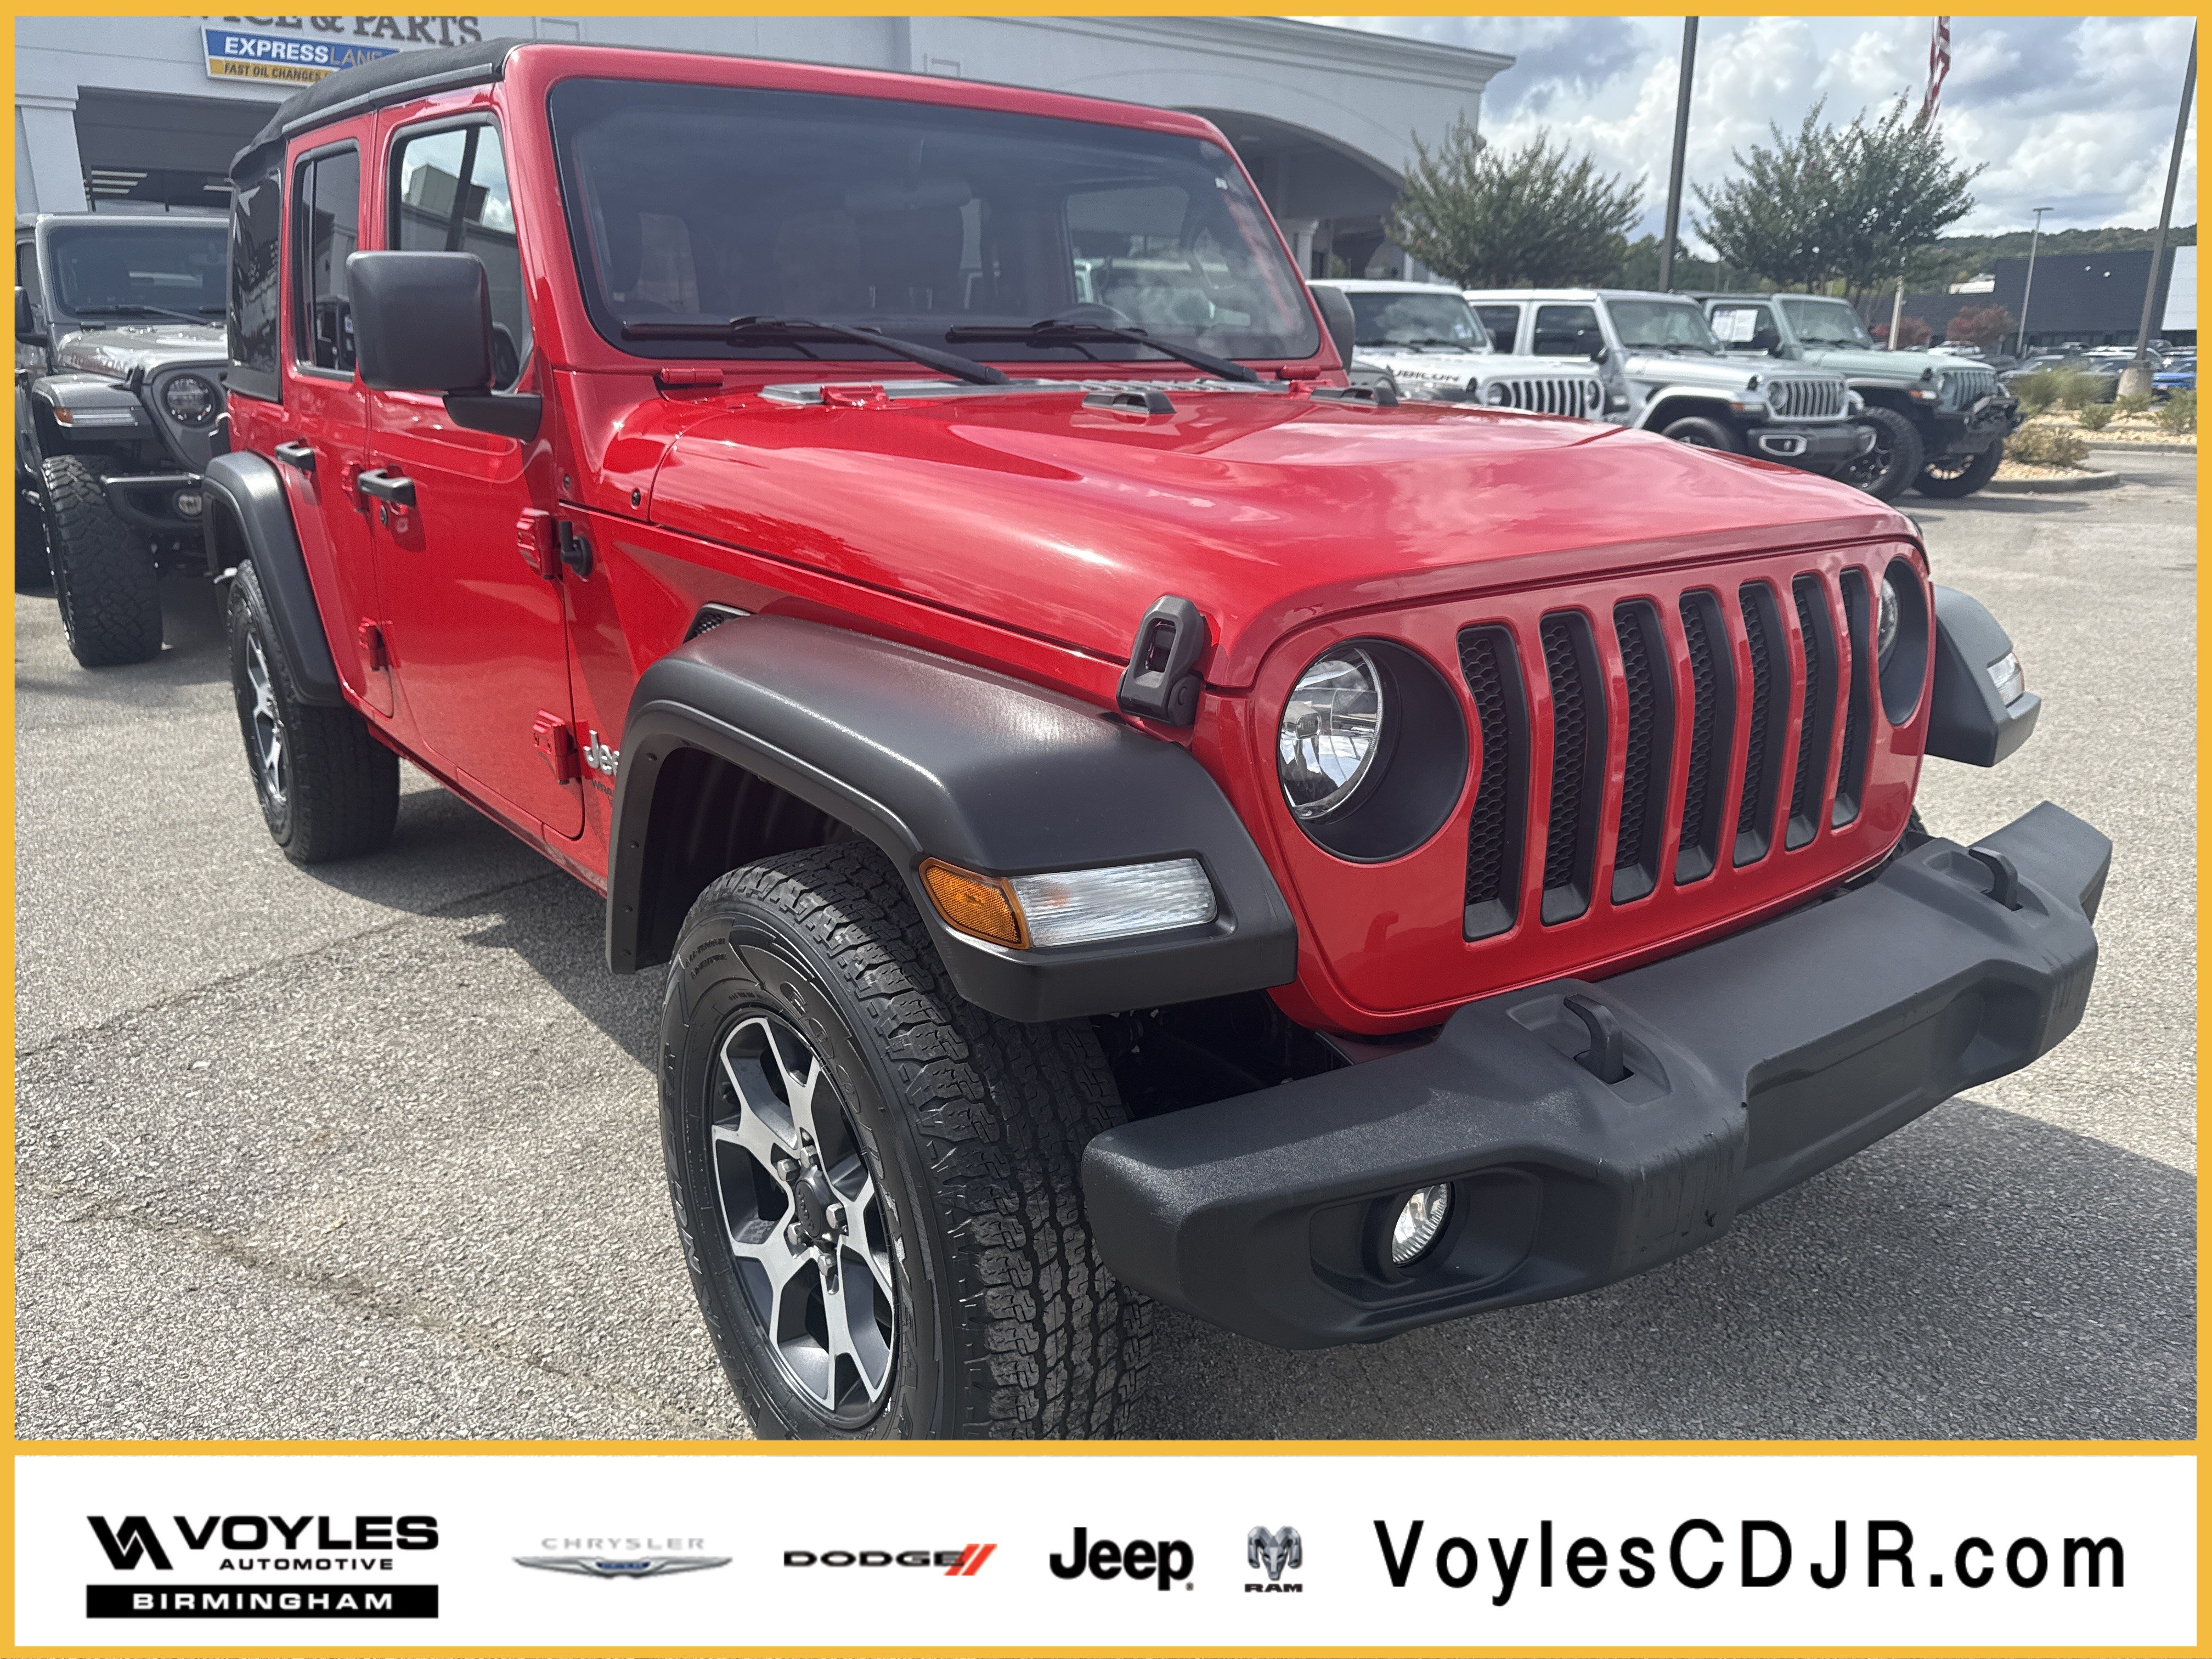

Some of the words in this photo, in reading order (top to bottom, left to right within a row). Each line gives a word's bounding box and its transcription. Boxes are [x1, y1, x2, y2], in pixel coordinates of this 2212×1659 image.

[353, 16, 482, 47] PARTS
[224, 62, 251, 75] FAST
[253, 65, 269, 77] OIL
[272, 67, 321, 81] CHANGES
